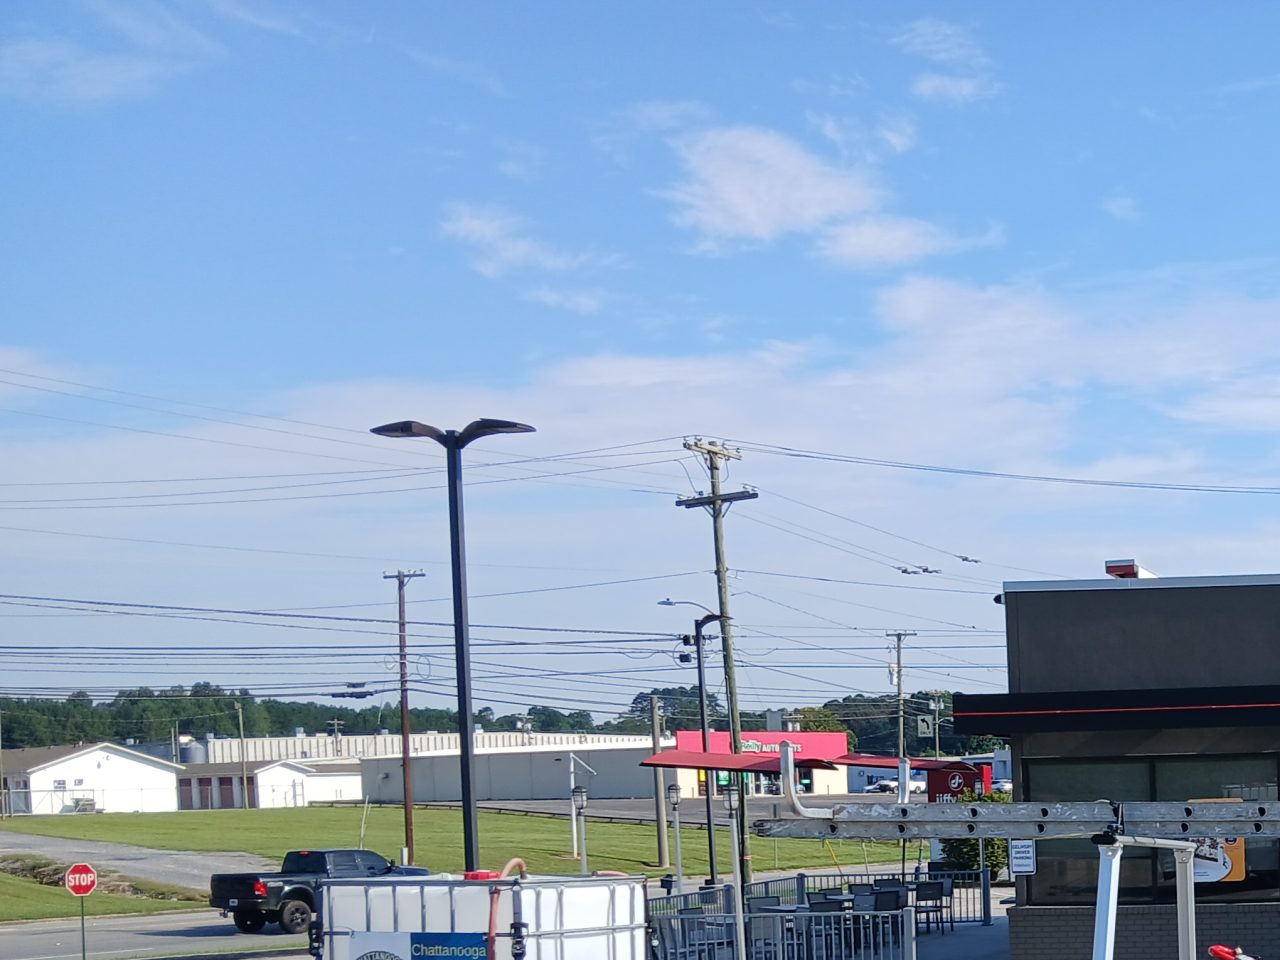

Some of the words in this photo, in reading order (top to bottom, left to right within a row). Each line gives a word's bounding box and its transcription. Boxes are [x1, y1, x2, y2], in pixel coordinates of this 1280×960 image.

[741, 740, 762, 752] Reilly
[68, 873, 95, 886] STOP
[412, 944, 487, 959] Chattanooga
